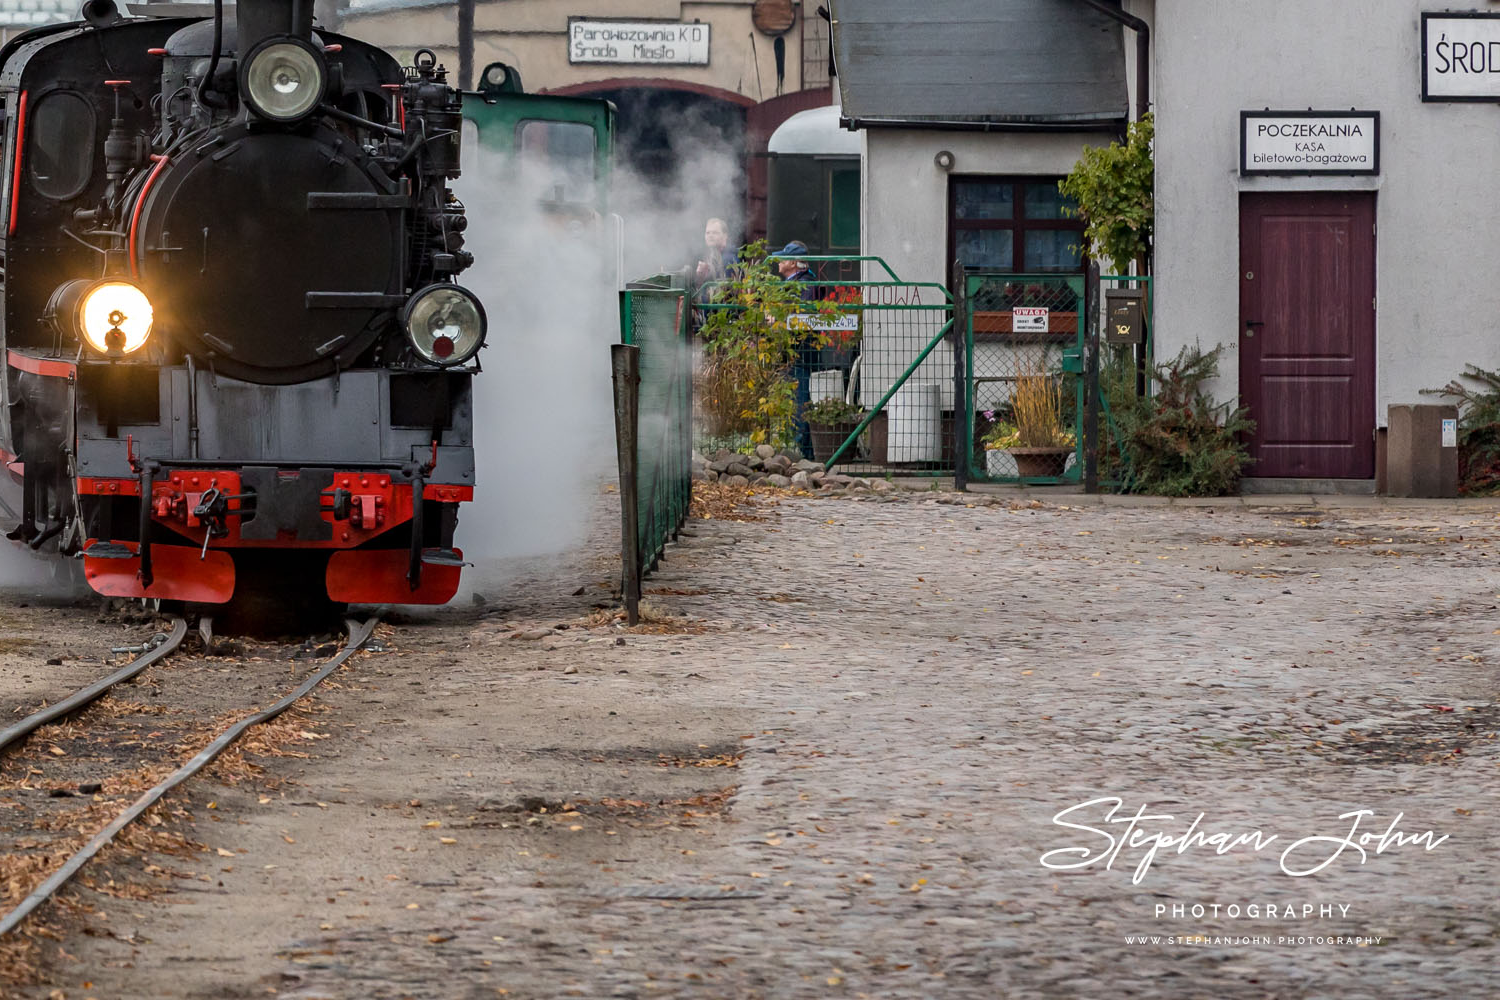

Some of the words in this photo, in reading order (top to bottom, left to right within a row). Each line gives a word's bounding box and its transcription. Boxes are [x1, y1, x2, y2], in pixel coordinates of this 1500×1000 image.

[573, 25, 675, 42] Parowozownia
[633, 43, 675, 60] Miasto
[1258, 124, 1363, 138] POCZEKALNIA
[1295, 142, 1326, 153] KASA
[1253, 153, 1367, 165] biletowo-bagażowa
